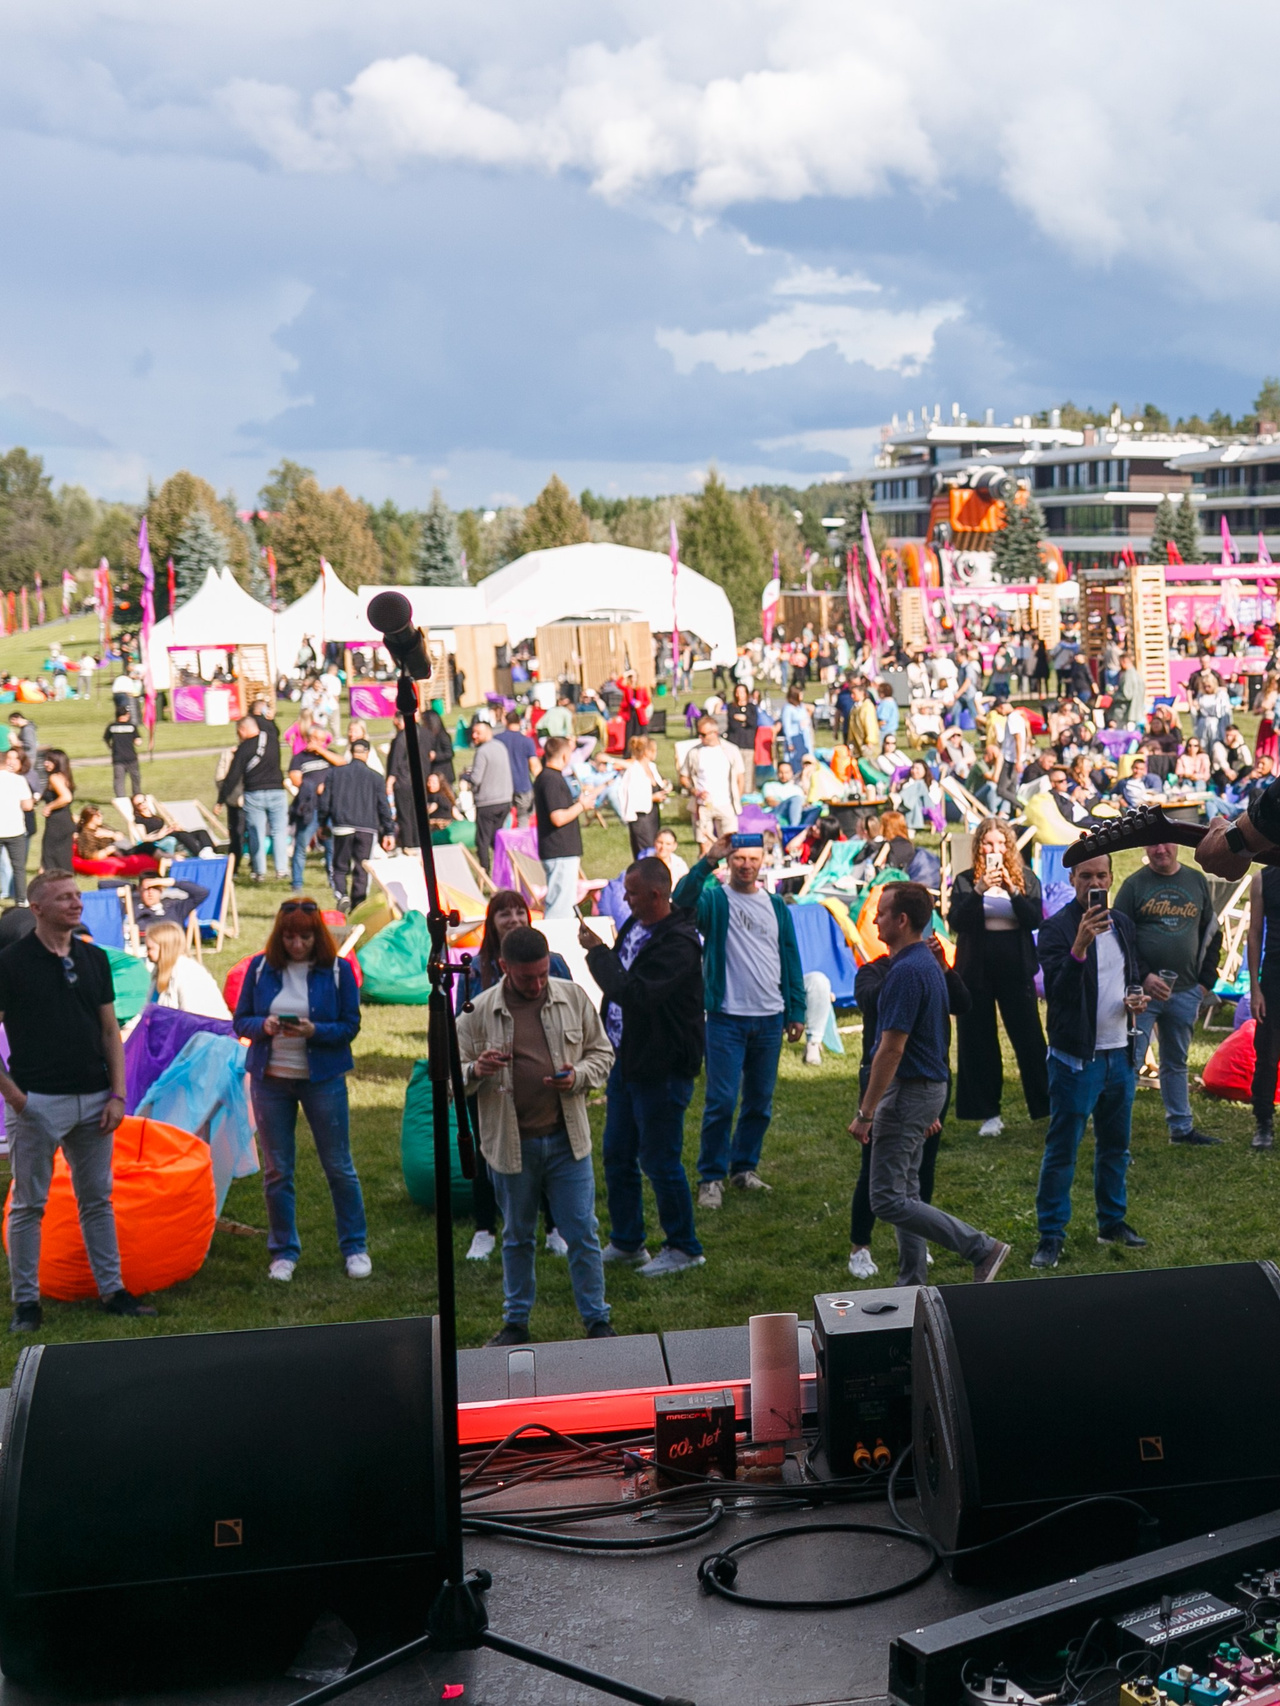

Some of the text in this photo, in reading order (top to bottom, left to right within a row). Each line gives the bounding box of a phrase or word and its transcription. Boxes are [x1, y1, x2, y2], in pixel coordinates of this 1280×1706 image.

[1141, 898, 1198, 917] Authentic
[698, 1427, 721, 1448] Jet
[1181, 1604, 1216, 1619] PEDAL
